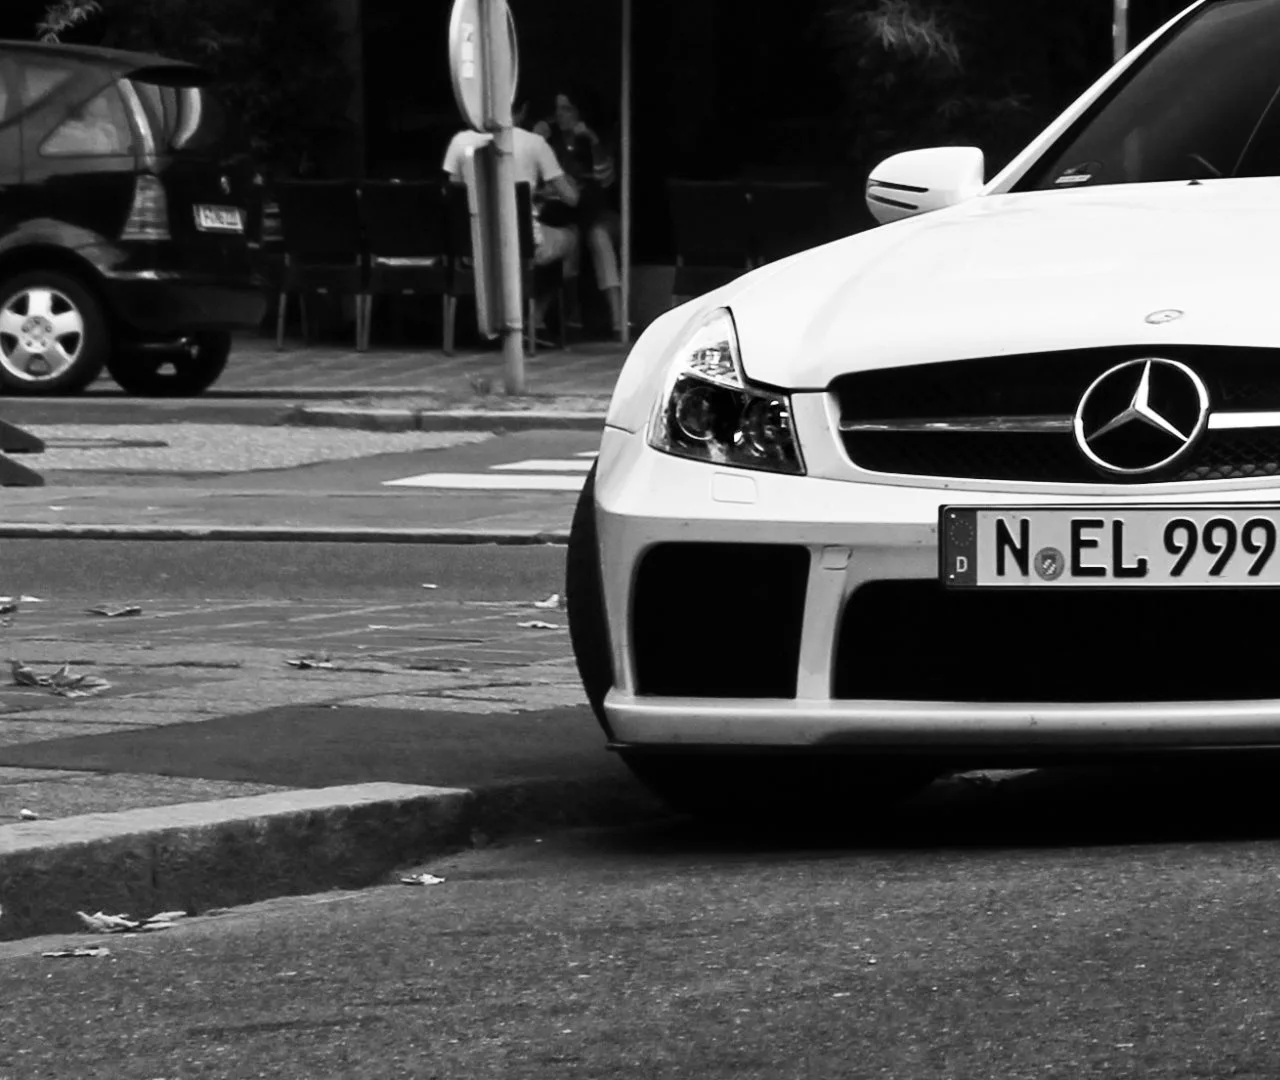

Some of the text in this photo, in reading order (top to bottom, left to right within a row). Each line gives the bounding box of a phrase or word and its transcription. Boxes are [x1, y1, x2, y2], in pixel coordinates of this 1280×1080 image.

[956, 555, 969, 572] D
[995, 518, 1277, 578] N EL 999
